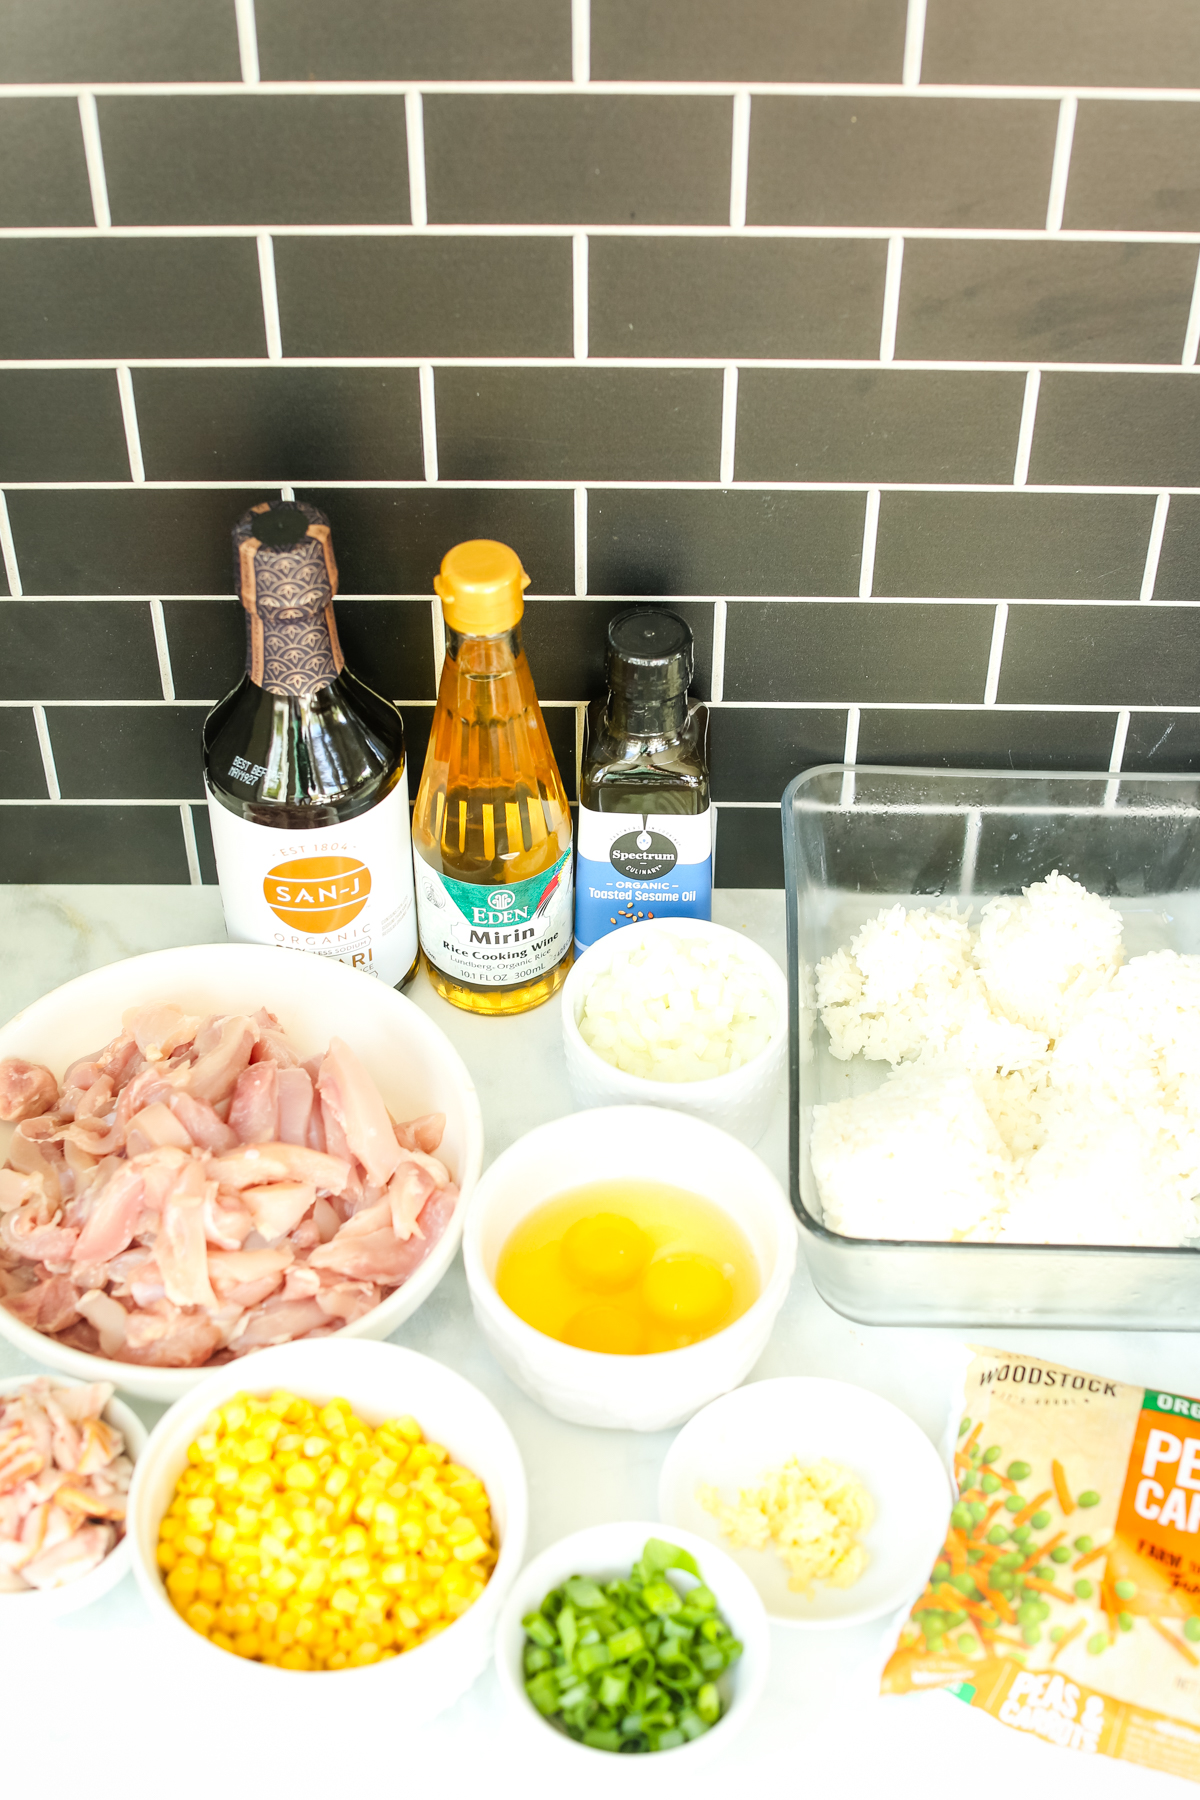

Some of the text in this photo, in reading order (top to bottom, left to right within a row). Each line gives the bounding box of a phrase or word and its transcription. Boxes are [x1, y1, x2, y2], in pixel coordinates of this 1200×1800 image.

[232, 755, 252, 771] BEST
[279, 842, 348, 857] EST 1804
[612, 849, 675, 861] Spectrum
[625, 865, 661, 875] CULINARY
[276, 877, 360, 904] SAN-J
[615, 881, 670, 890] ORGANIC
[588, 887, 697, 902] Toasted Sesame Oil
[471, 905, 529, 924] EDEN
[273, 923, 371, 945] ORGANIC
[469, 927, 535, 945] Mirin
[334, 940, 367, 954] SODIUM
[442, 940, 469, 958] Rice
[472, 949, 528, 961] Cooking
[531, 932, 559, 951] Wine
[497, 957, 533, 970] Organic
[535, 948, 551, 961] Rice
[460, 969, 476, 980] 10.1
[979, 1364, 1117, 1397] WOODSTOCK
[1008, 1671, 1081, 1719] PEAS
[1080, 1695, 1105, 1733] &
